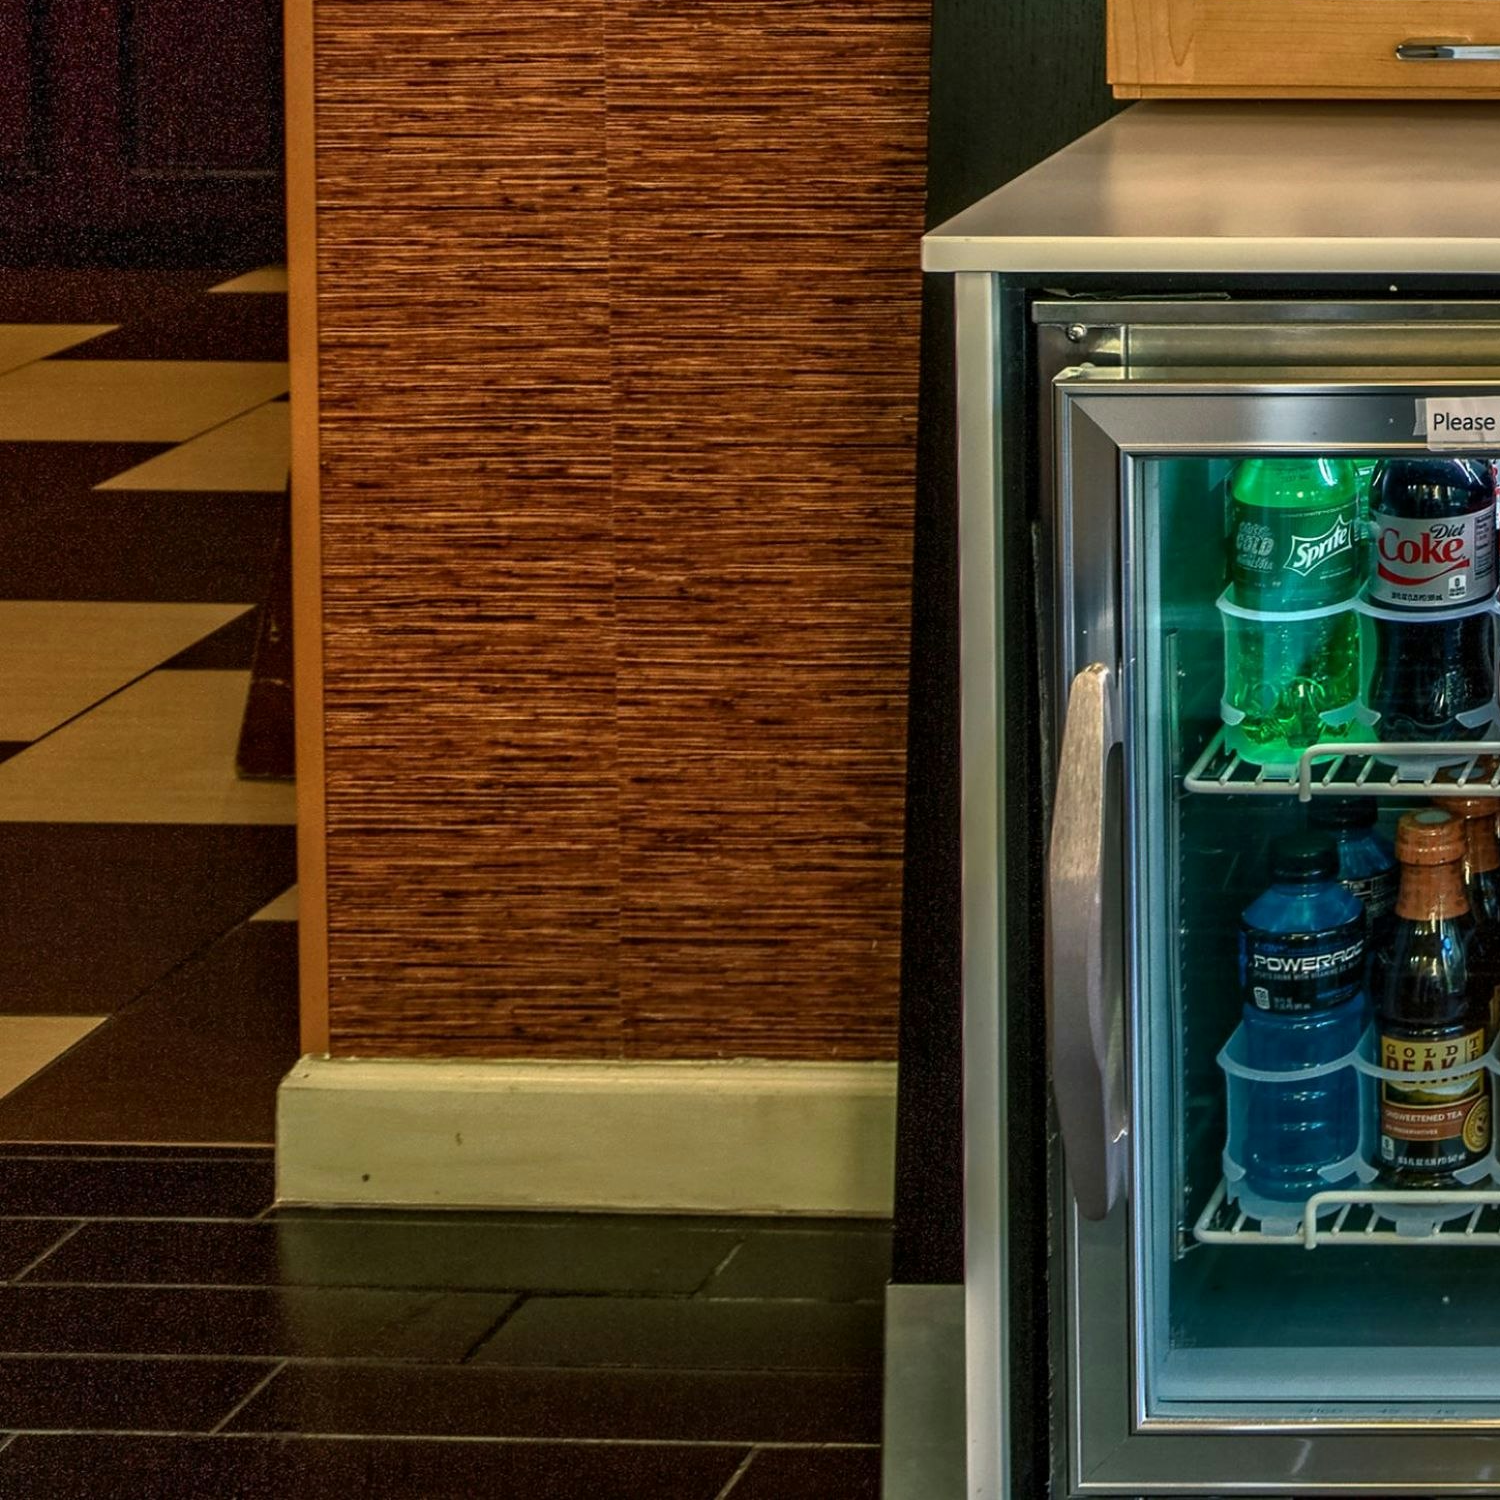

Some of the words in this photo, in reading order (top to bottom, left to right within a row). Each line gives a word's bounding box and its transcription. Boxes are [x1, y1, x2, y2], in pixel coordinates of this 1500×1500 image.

[1433, 413, 1496, 432] Please
[1429, 522, 1465, 540] Diet
[1292, 524, 1349, 569] Sprite
[1377, 526, 1463, 565] Coke
[1386, 1043, 1459, 1059] GOLD
[1447, 1110, 1463, 1121] TEA
